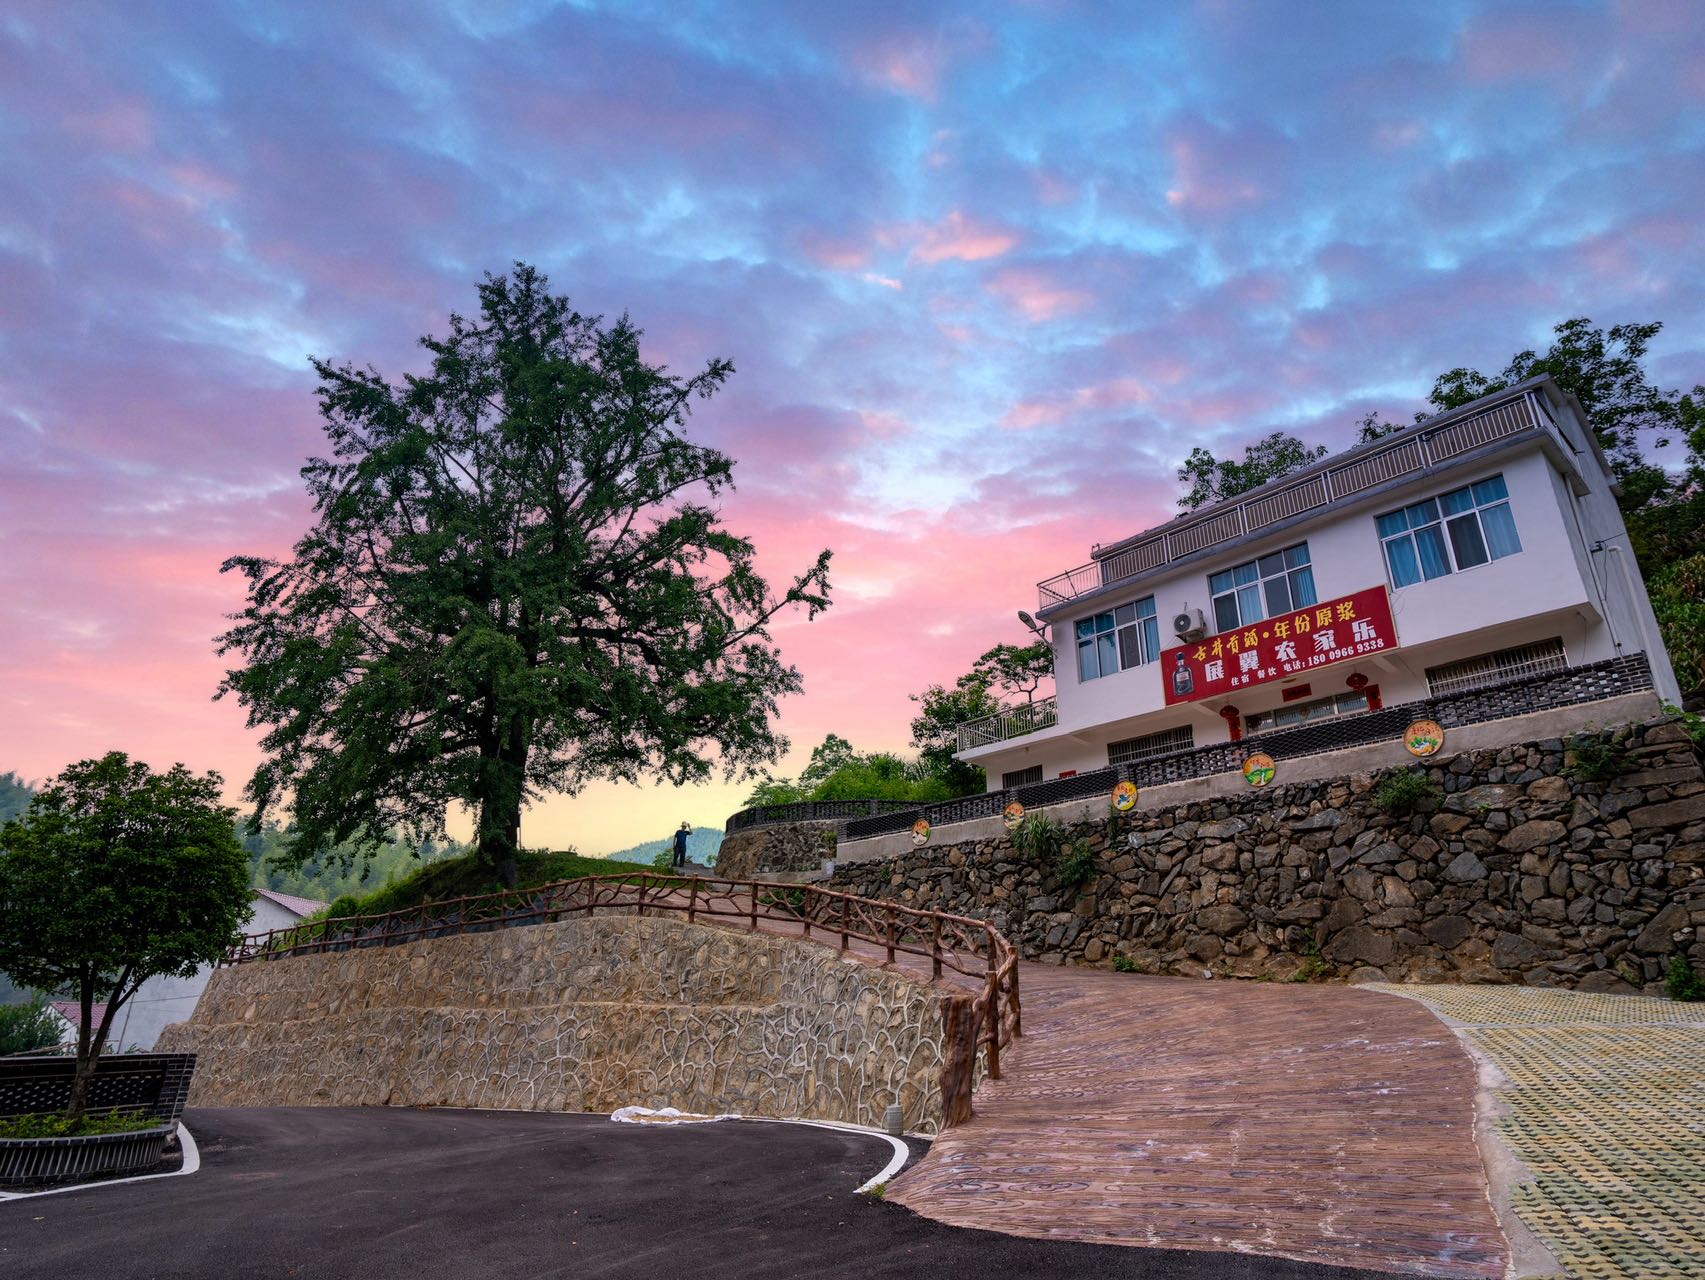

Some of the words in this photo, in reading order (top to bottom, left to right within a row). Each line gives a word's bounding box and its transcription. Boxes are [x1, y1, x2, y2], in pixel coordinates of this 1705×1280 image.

[1231, 674, 1249, 686] 住宿
[1257, 667, 1277, 679] 餐饮
[1308, 654, 1326, 667] 180
[1329, 647, 1354, 660] 0966
[1358, 638, 1384, 653] 9338
